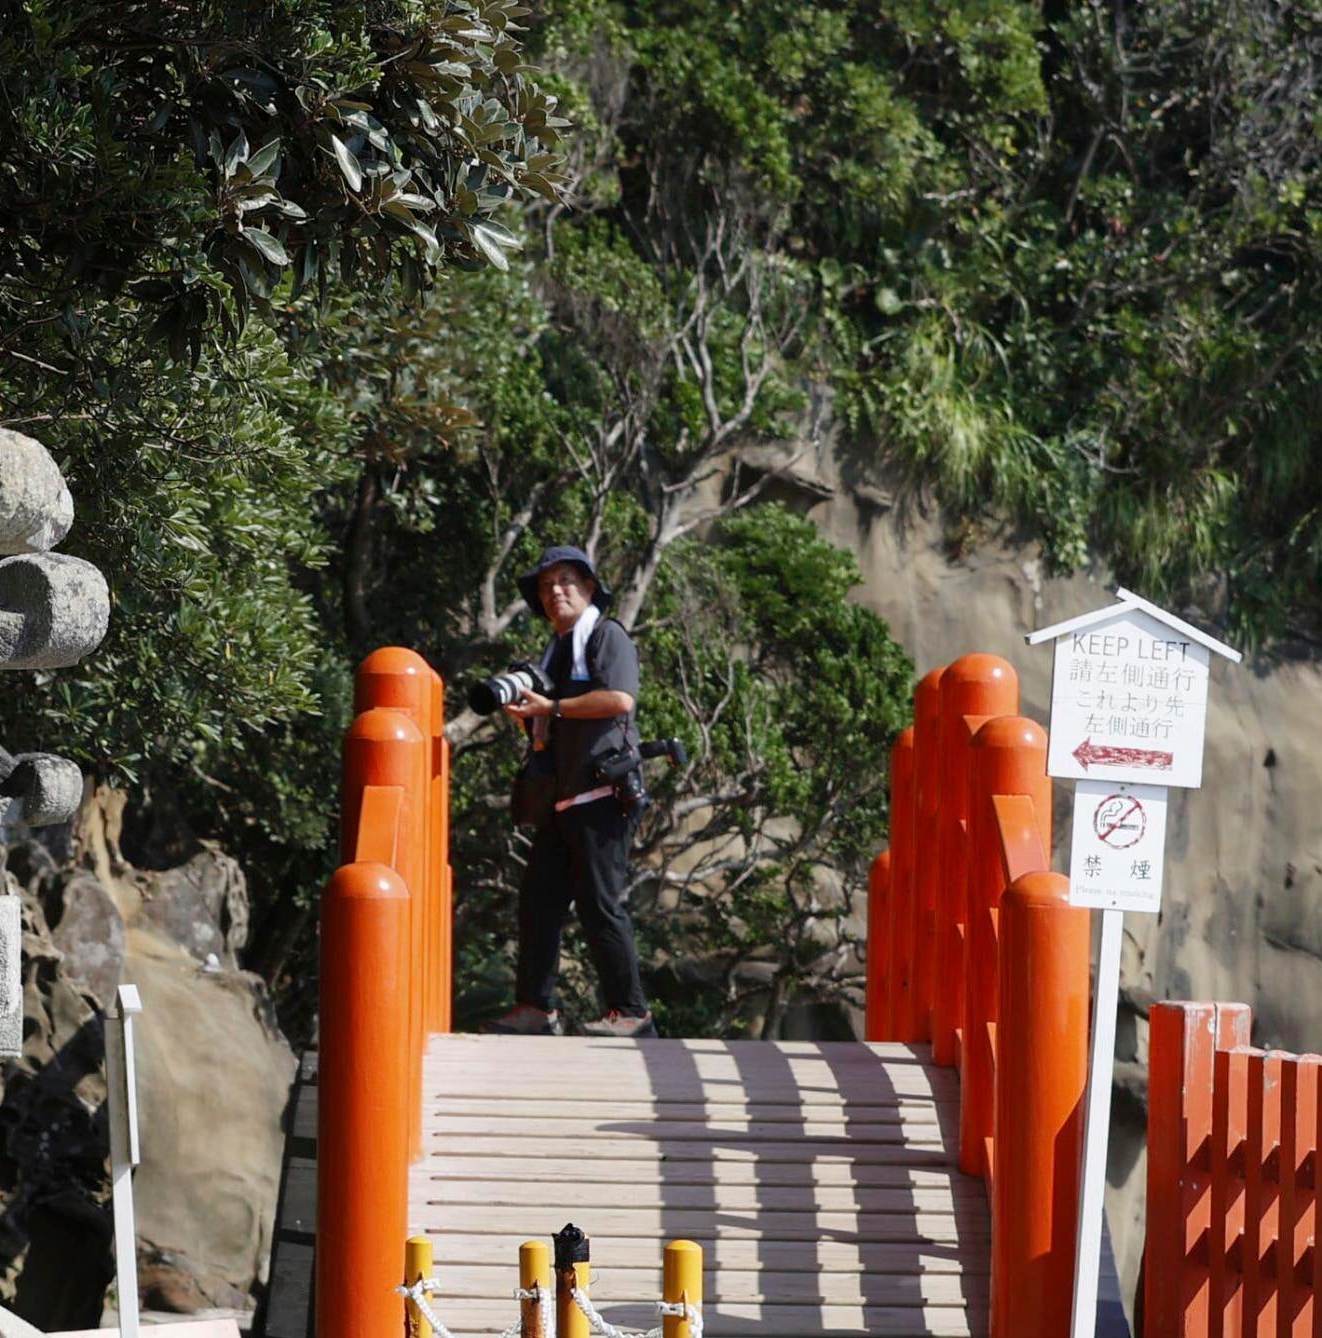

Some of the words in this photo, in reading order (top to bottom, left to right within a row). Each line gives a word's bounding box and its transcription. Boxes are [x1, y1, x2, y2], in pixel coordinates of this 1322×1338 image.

[1072, 632, 1129, 657] KEEP
[1137, 638, 1191, 662] LEFT
[1069, 658, 1197, 692] 請左側通行
[1077, 689, 1185, 718] これより先
[1084, 713, 1174, 739] 左側通行
